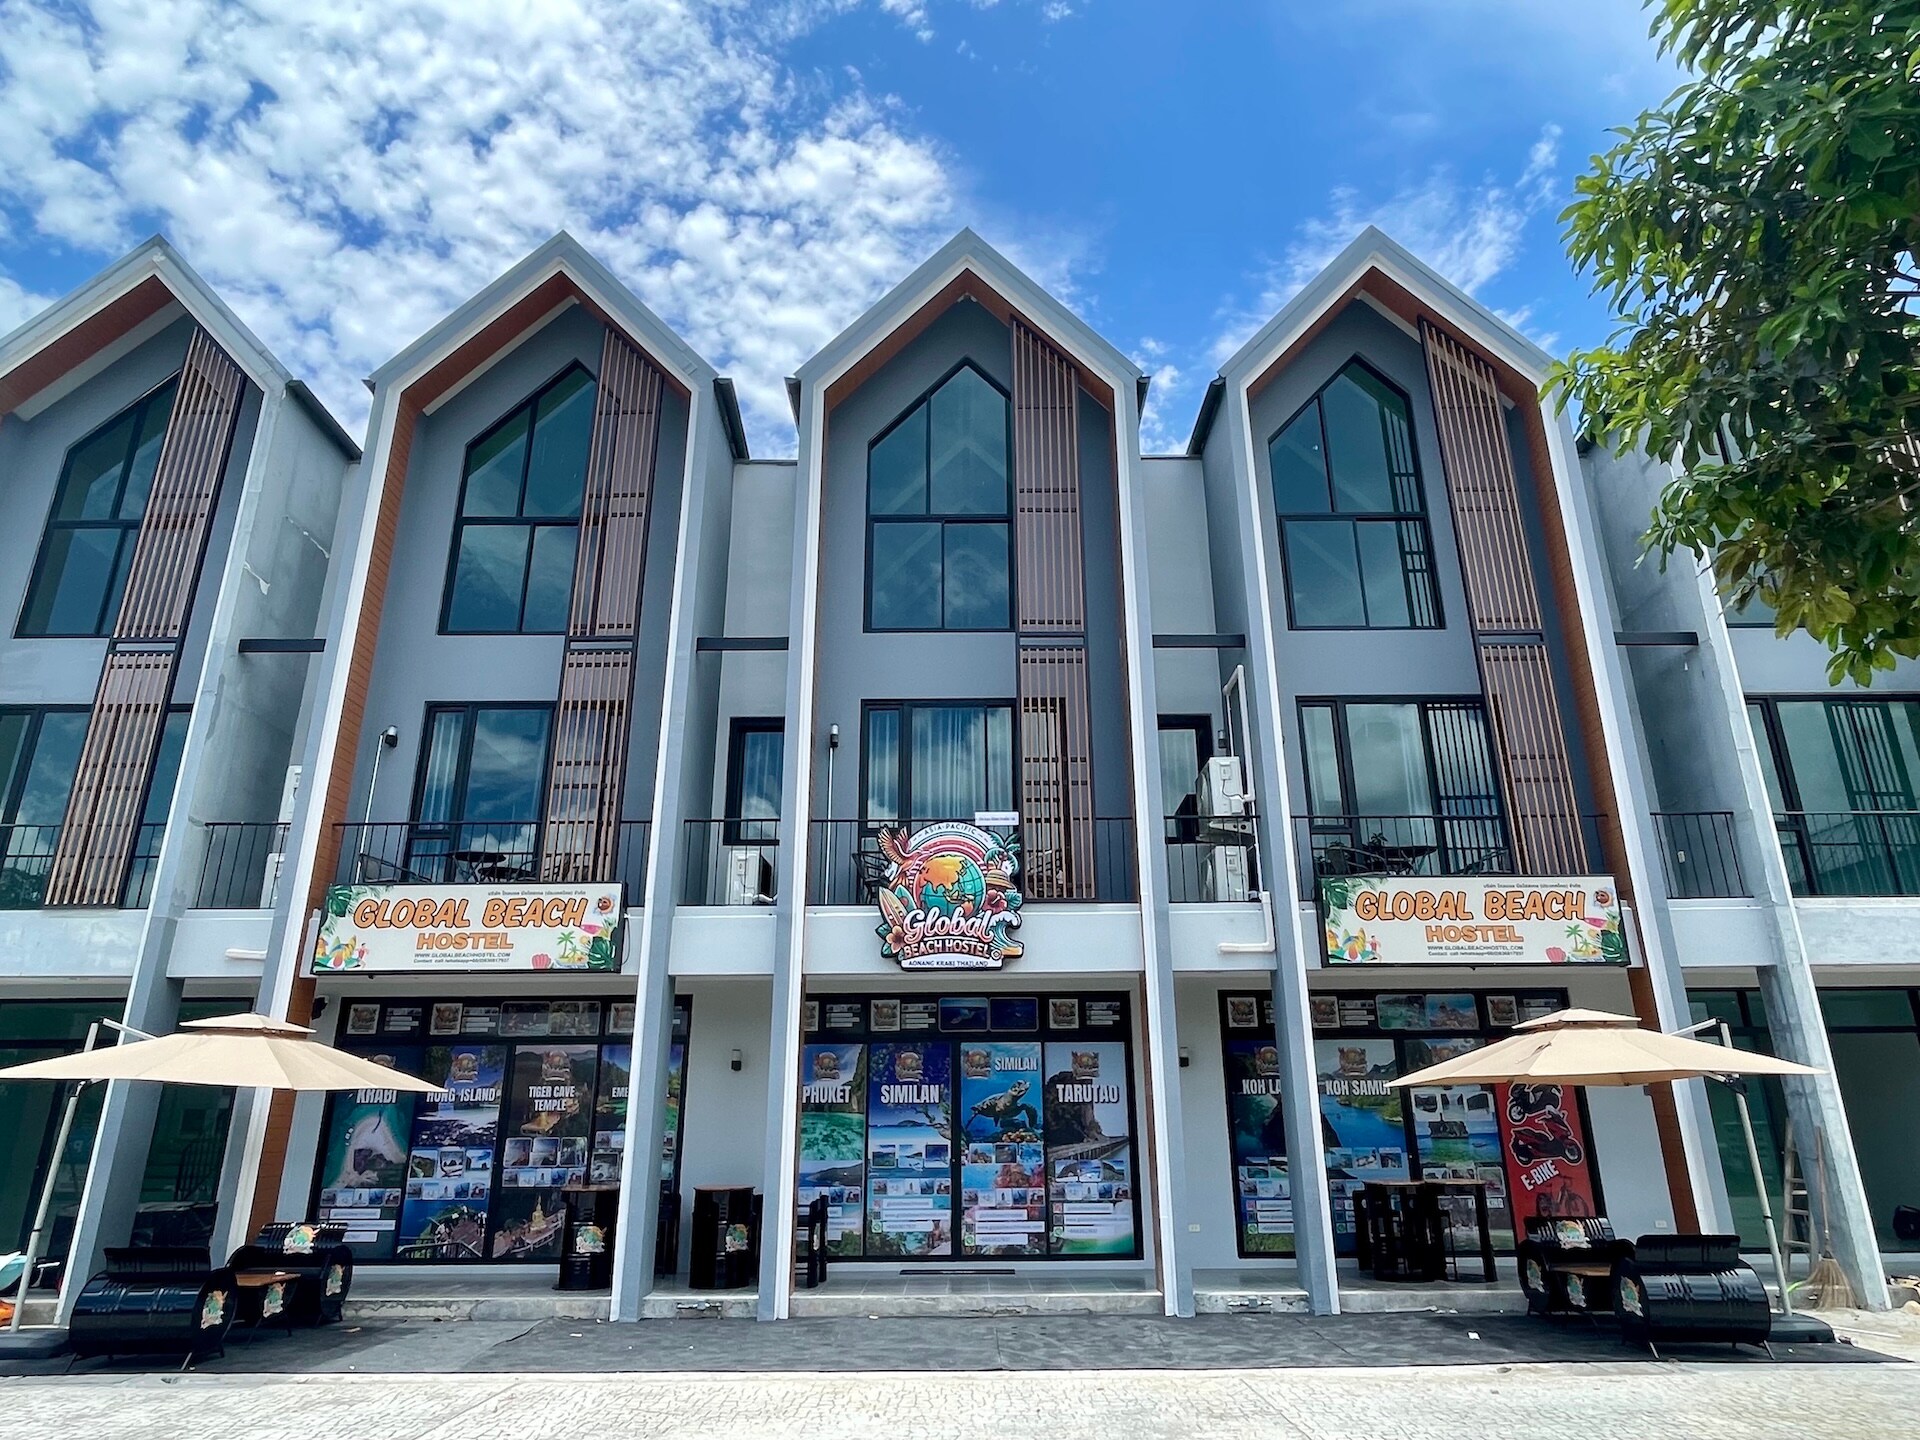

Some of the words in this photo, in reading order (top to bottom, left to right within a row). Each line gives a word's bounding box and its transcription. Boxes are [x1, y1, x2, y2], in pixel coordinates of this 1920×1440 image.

[354, 897, 470, 928] GLOBAL
[482, 897, 589, 928] BEACH
[1355, 890, 1472, 921] GLOBAL
[1484, 890, 1586, 921] BEACH
[903, 906, 994, 943] Global
[416, 932, 514, 950] HOSTEL
[1425, 925, 1524, 943] HOSTEL
[904, 940, 942, 958] BEACH
[945, 940, 990, 958] HOSTEL
[995, 1057, 1037, 1071] SIMILAN
[460, 1087, 496, 1102] ISLAND
[528, 1085, 552, 1098] TIGER
[553, 1085, 576, 1098] CAVE
[802, 1085, 851, 1104] PHUKET
[880, 1084, 940, 1104] SIMILAN
[1056, 1083, 1119, 1103] TARUTAO
[1242, 1078, 1266, 1095] KOH
[1268, 1078, 1281, 1095] LA
[1326, 1080, 1349, 1096] KOH
[1351, 1080, 1391, 1096] SAMUI
[356, 1089, 398, 1104] KRABI
[534, 1099, 567, 1111] TEMPLE
[1520, 1159, 1560, 1191] E-BIKE
